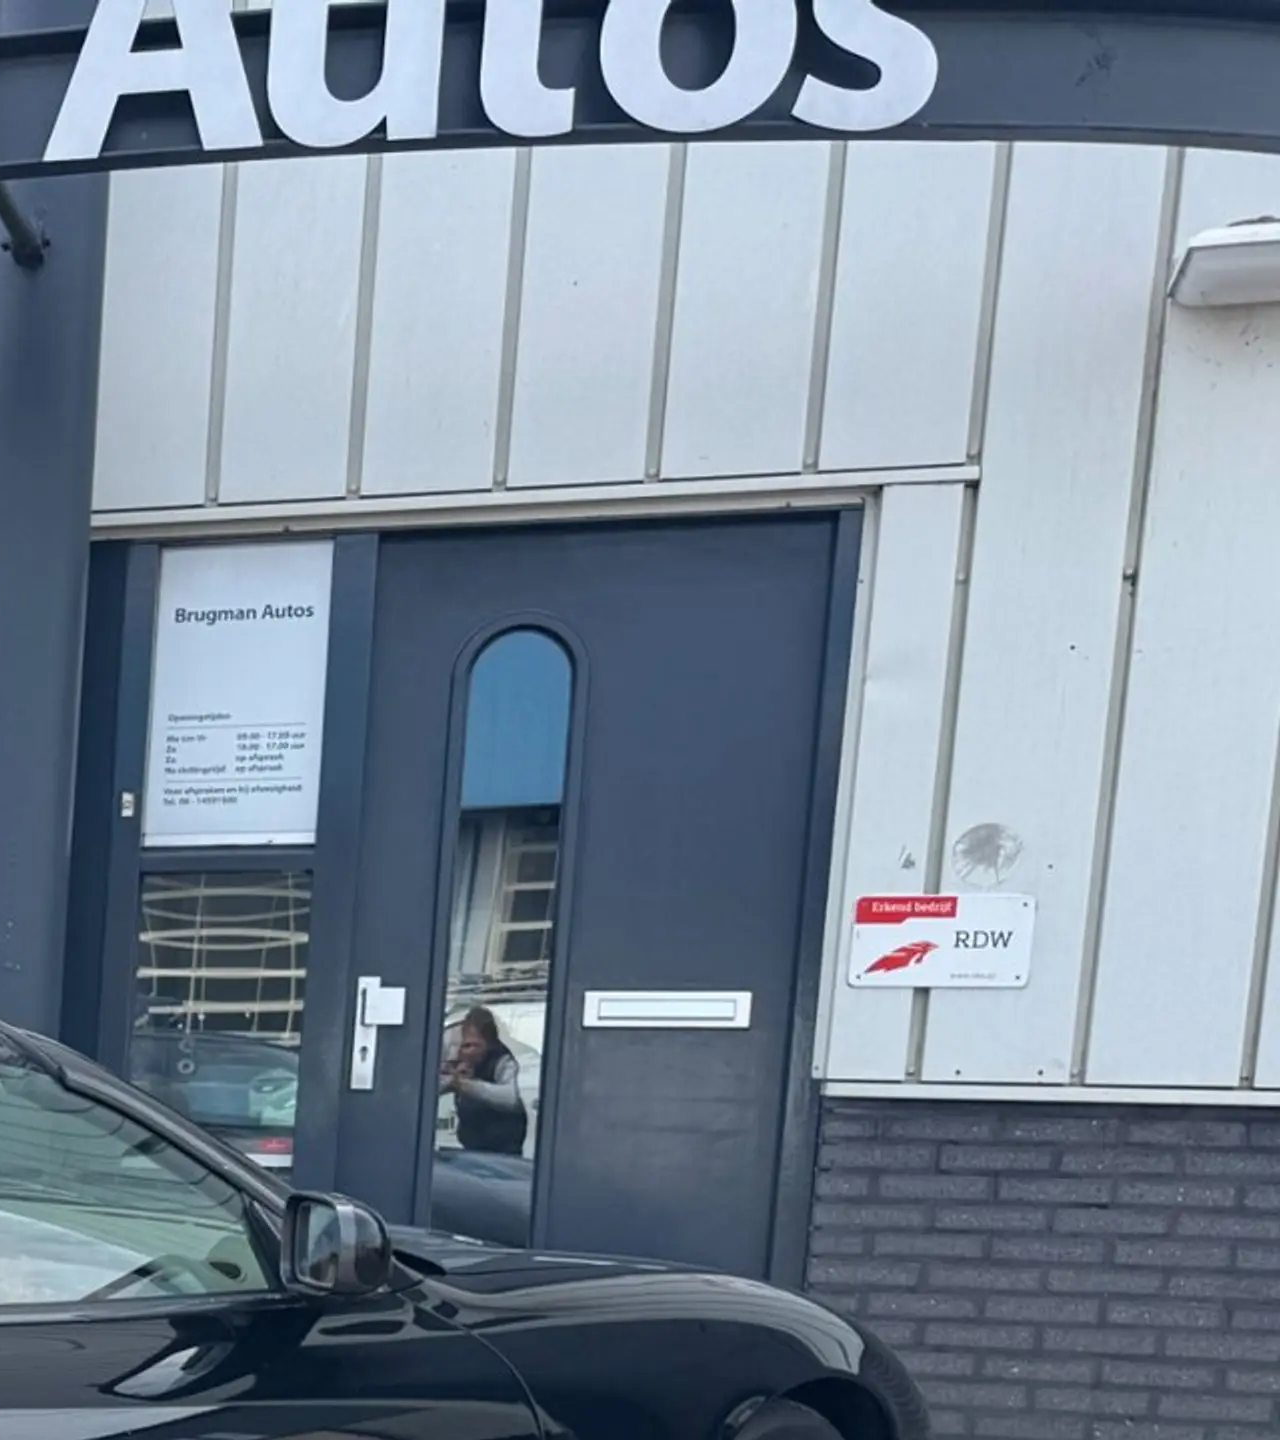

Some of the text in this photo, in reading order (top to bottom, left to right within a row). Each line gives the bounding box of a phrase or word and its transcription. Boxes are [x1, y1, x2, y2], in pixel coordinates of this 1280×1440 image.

[42, 0, 939, 162] Autos
[175, 604, 314, 625] Brugman Autos
[871, 900, 954, 915] Erkend bedrijf
[953, 929, 1014, 949] RDW
